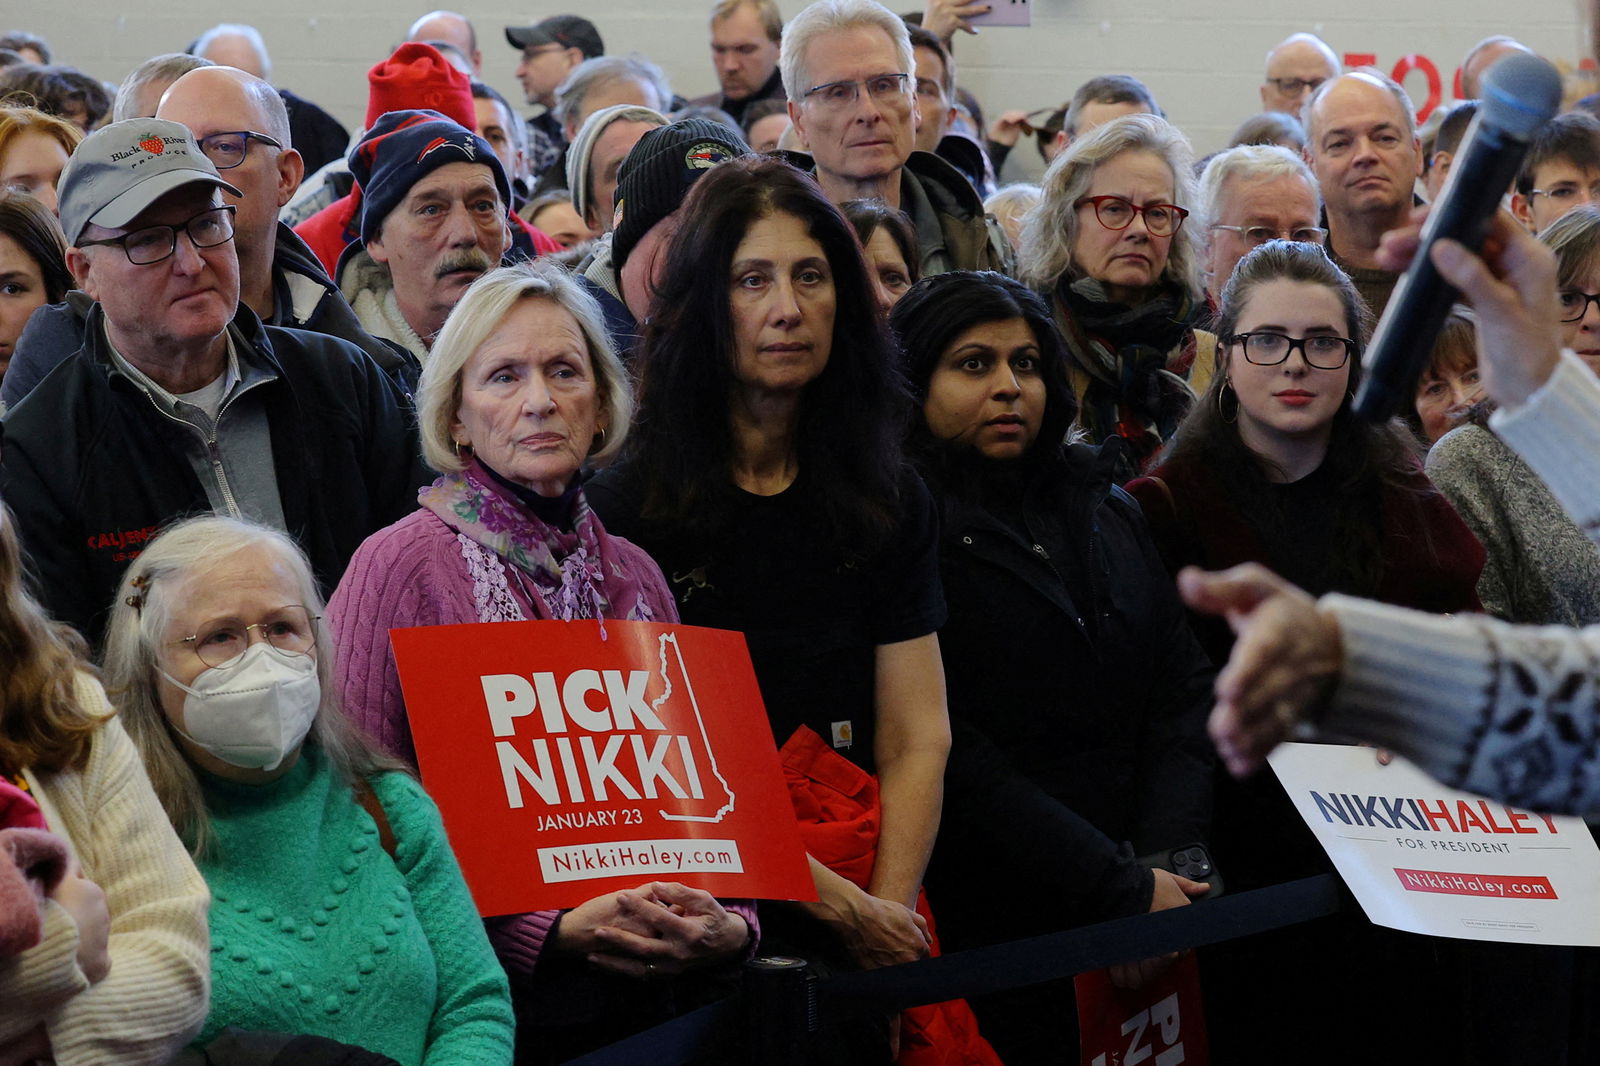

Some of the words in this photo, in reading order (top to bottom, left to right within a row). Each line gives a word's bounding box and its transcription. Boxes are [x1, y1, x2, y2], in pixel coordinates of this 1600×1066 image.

[111, 145, 141, 162] Black
[163, 136, 186, 145] River
[131, 149, 188, 169] PRODUCE
[480, 669, 667, 737] PICK
[495, 734, 705, 808] NIKKI
[536, 810, 617, 832] JANUARY
[621, 808, 643, 825] 23
[1309, 790, 1557, 834] NIKKIHALEY
[1396, 837, 1427, 850] FOR
[1431, 840, 1511, 854] PRESIDENT
[552, 845, 732, 873] NikkiHaley.com
[1405, 872, 1547, 897] NikkiHaley.com
